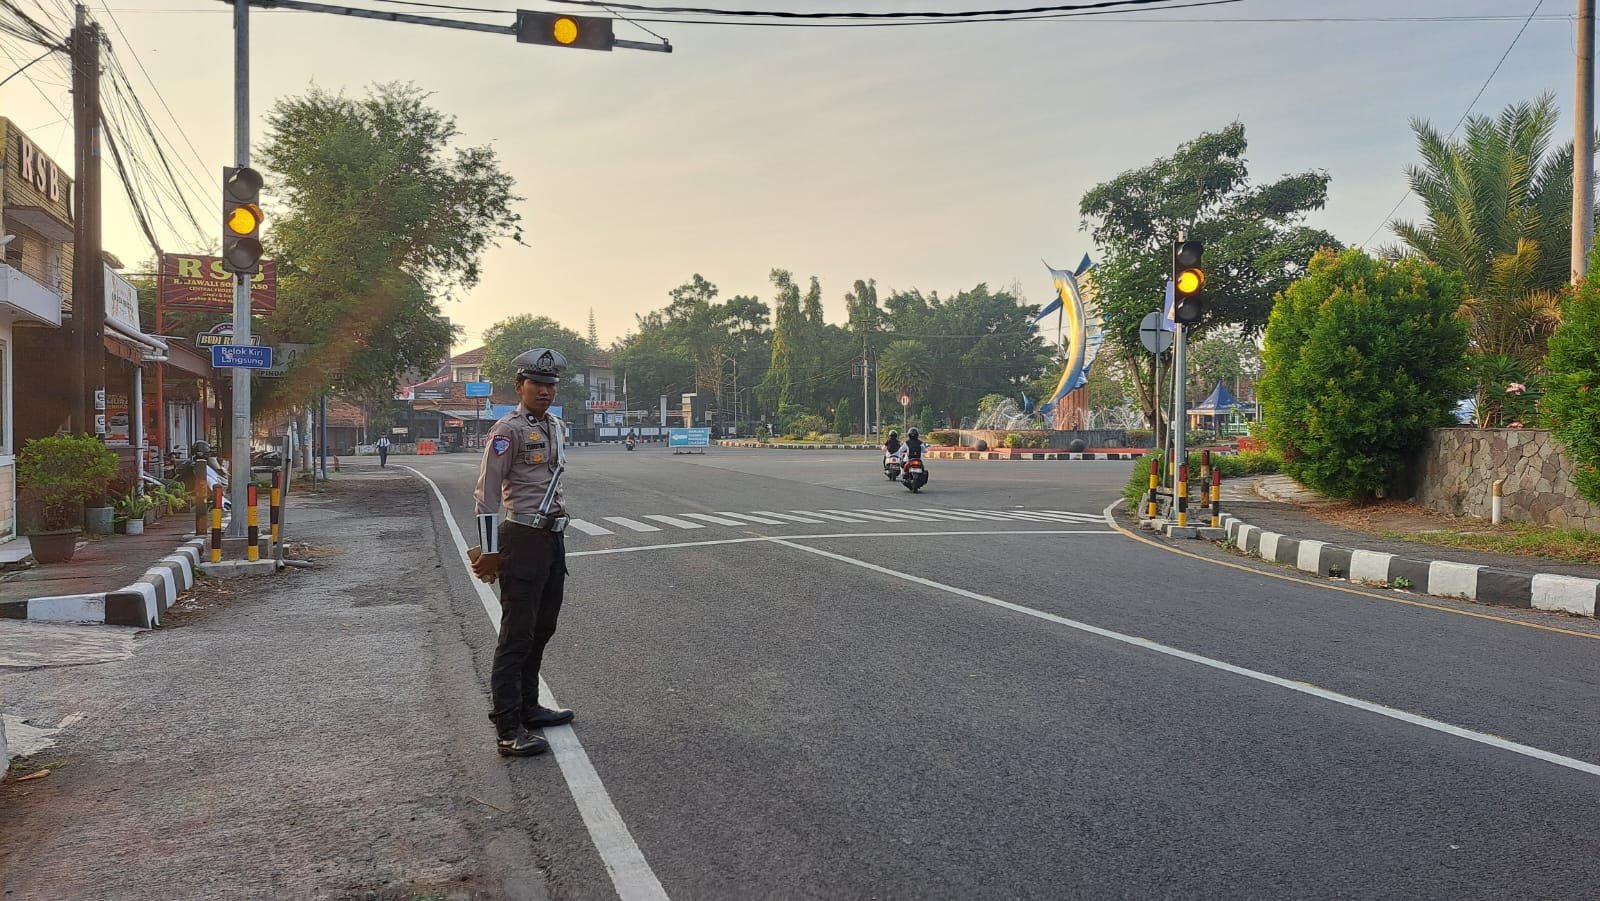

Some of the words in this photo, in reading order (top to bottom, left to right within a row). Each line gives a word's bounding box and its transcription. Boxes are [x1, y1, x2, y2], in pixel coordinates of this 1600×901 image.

[19, 136, 60, 202] RSB
[201, 335, 222, 344] BUDI
[221, 347, 246, 356] Belok
[248, 349, 263, 357] Kiri
[221, 356, 264, 366] Langsung
